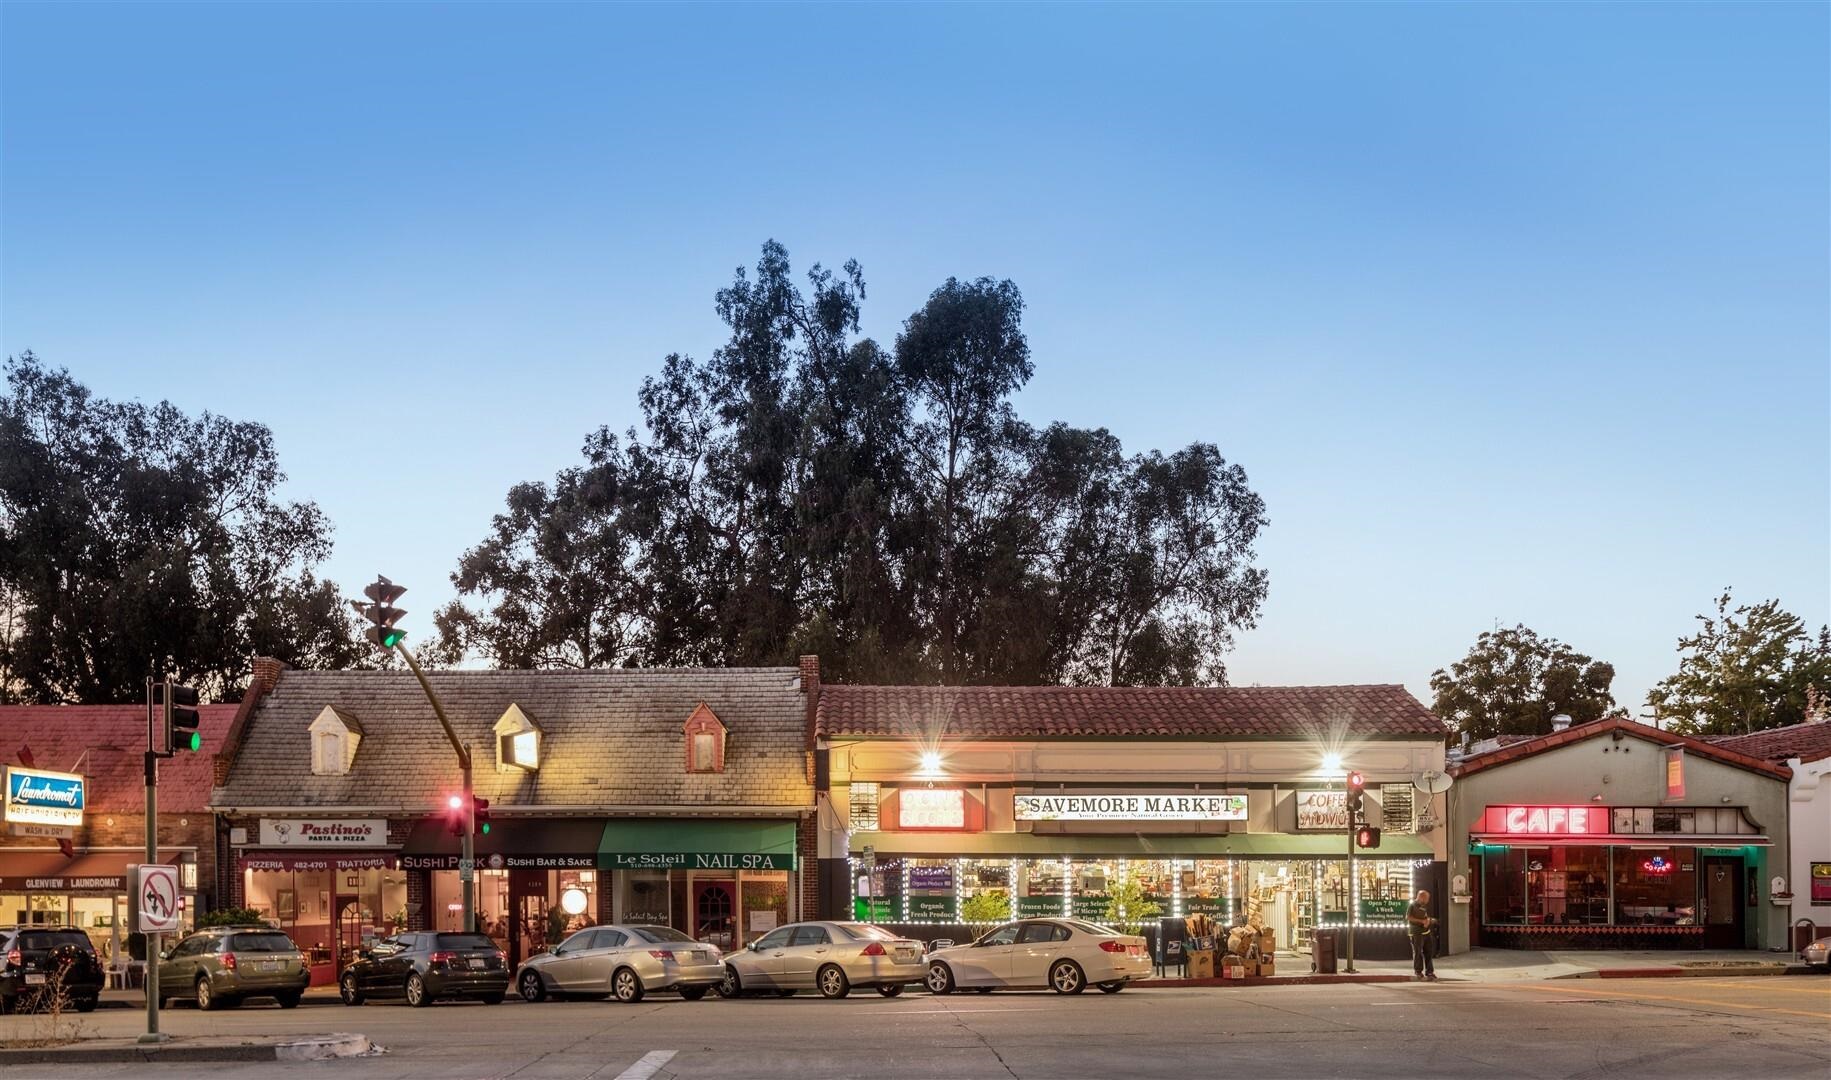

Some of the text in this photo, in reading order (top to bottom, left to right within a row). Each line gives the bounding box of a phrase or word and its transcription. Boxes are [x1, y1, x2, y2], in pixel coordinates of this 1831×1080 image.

[12, 777, 81, 806] Laundromat
[1030, 798, 1233, 812] SAVEMORE MARKET
[1507, 807, 1586, 833] CAFE
[25, 826, 42, 835] WASH
[51, 827, 64, 836] DRY
[301, 823, 372, 836] Pastino's
[336, 858, 385, 868] TRATTORIA
[404, 856, 444, 868] SUSHI
[448, 857, 485, 868] PK
[507, 858, 592, 866] SUSHI BAR & SAKE
[616, 854, 685, 864] Le Soleil
[696, 854, 774, 868] NAIL SPA
[1644, 862, 1670, 872] Coffee
[26, 878, 120, 888] GLENVIEW LAUNDROMAT
[630, 912, 645, 920] Soleil
[647, 912, 657, 922] Day
[659, 912, 668, 922] Spa
